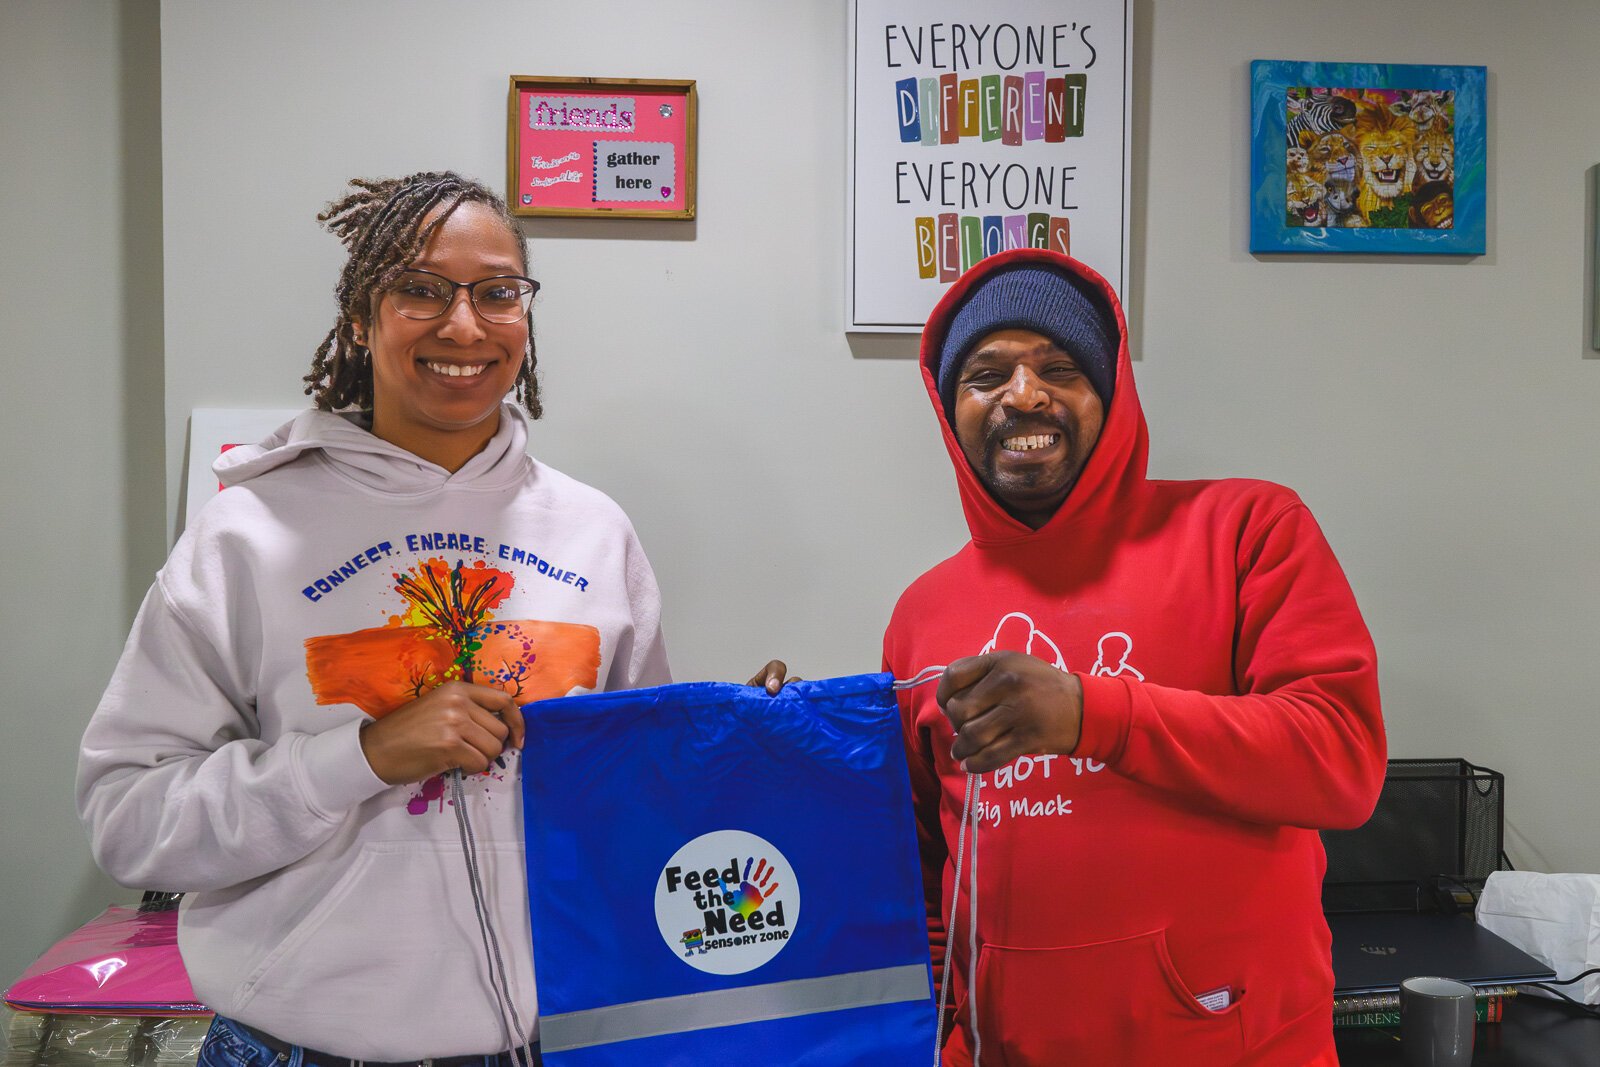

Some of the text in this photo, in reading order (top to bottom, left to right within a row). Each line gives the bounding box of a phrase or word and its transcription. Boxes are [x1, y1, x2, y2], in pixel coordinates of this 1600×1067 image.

[885, 22, 1097, 72] EVERYONE'S
[534, 101, 633, 130] friends
[900, 83, 1083, 133] DIFFERENT
[606, 152, 661, 168] gather
[615, 175, 653, 189] here
[896, 161, 1078, 210] EVERYONE
[918, 223, 1069, 271] BELONGS
[498, 543, 590, 593] EMPOWER
[993, 754, 1058, 789] GOT
[1009, 794, 1073, 818] Mack
[665, 858, 741, 893] Feed
[693, 889, 735, 910] the
[704, 900, 785, 937] Need
[1332, 1012, 1400, 1027] HILDREN'S
